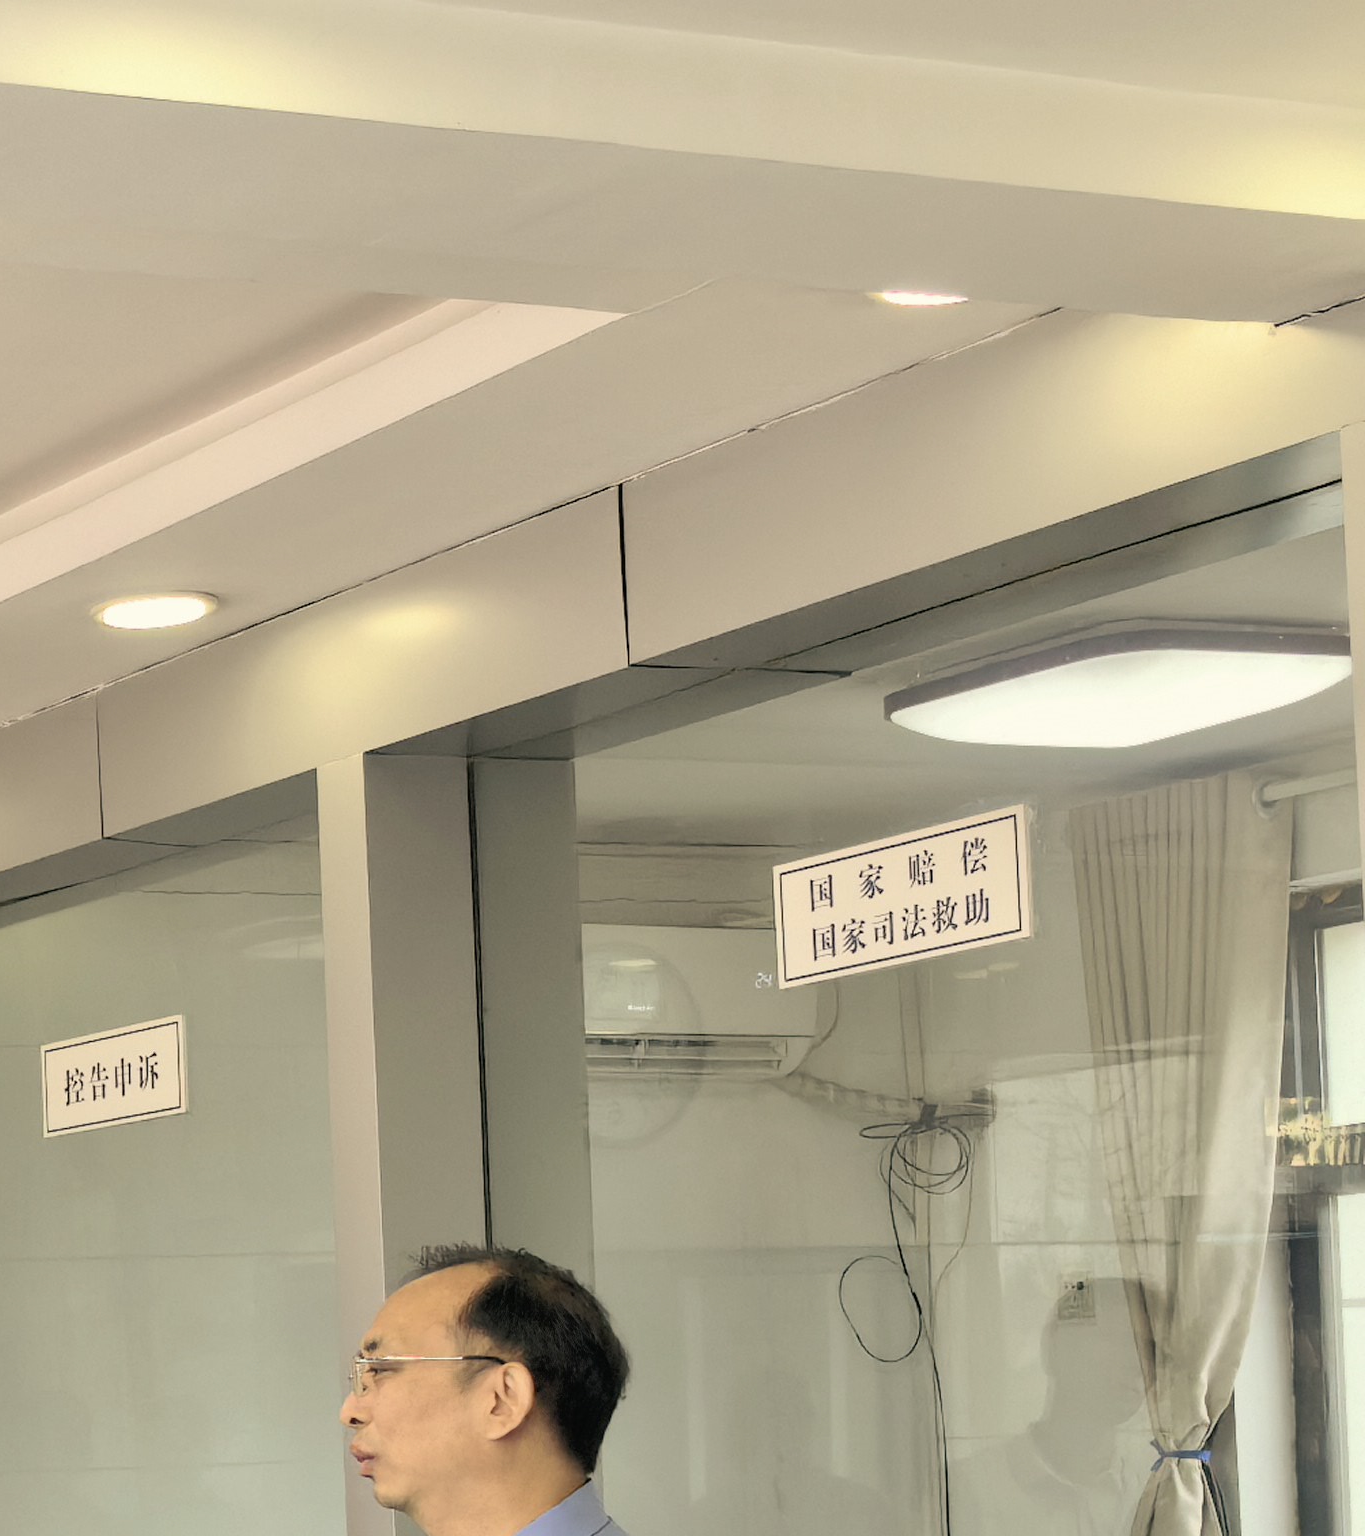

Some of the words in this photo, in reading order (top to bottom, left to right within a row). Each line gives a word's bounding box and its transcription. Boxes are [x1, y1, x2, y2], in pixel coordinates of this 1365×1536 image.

[809, 836, 989, 912] 国家赔偿
[812, 887, 990, 962] 国家司法救助
[64, 1051, 159, 1107] 控告申诉
